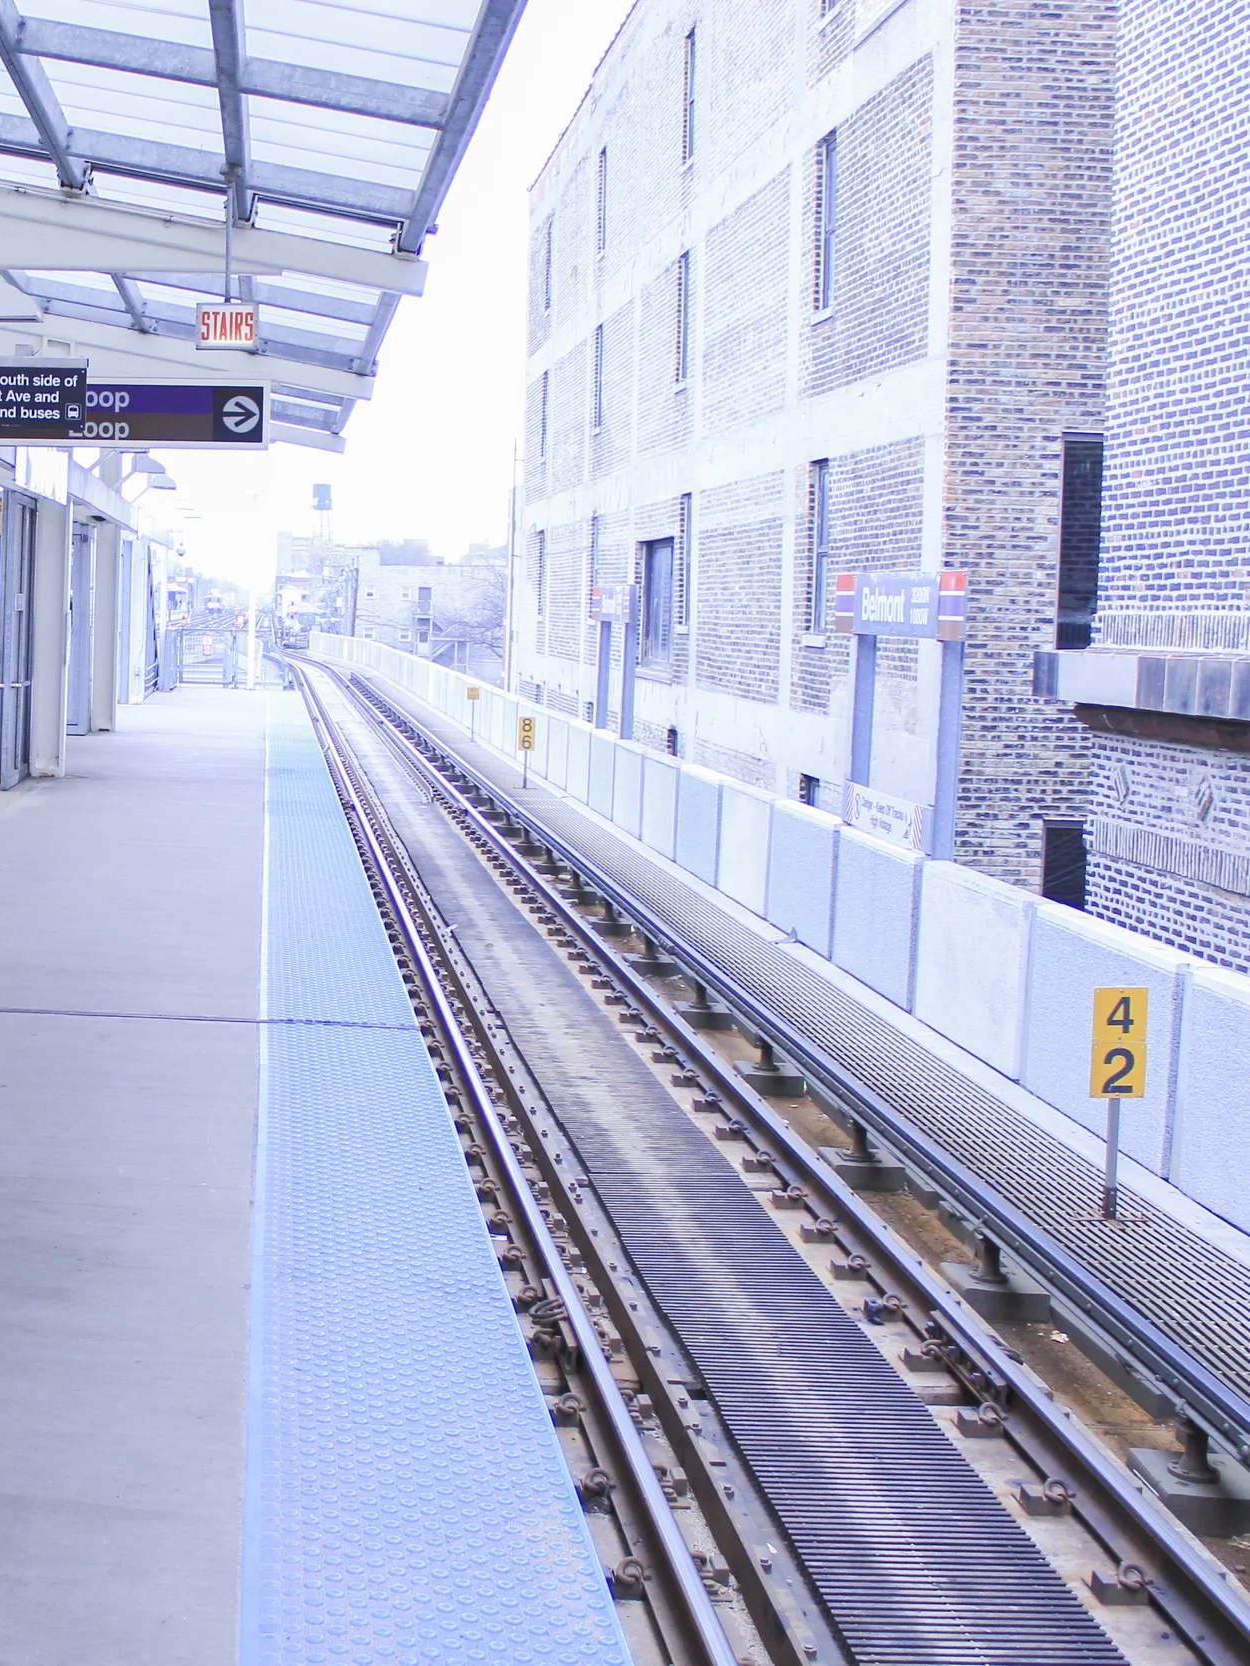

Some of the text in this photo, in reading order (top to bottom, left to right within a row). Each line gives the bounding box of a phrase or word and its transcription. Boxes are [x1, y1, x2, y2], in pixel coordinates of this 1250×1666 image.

[201, 311, 254, 341] STAIRS
[33, 374, 61, 387] side
[64, 375, 78, 387] of
[5, 390, 31, 402] Ave
[34, 391, 60, 403] and
[86, 391, 129, 412] oop
[20, 406, 60, 419] buses
[69, 422, 129, 440] oop
[862, 587, 905, 623] Belmont
[522, 718, 532, 732] 8
[522, 735, 532, 749] 6
[1107, 996, 1135, 1034] 4
[1102, 1047, 1135, 1094] 2
